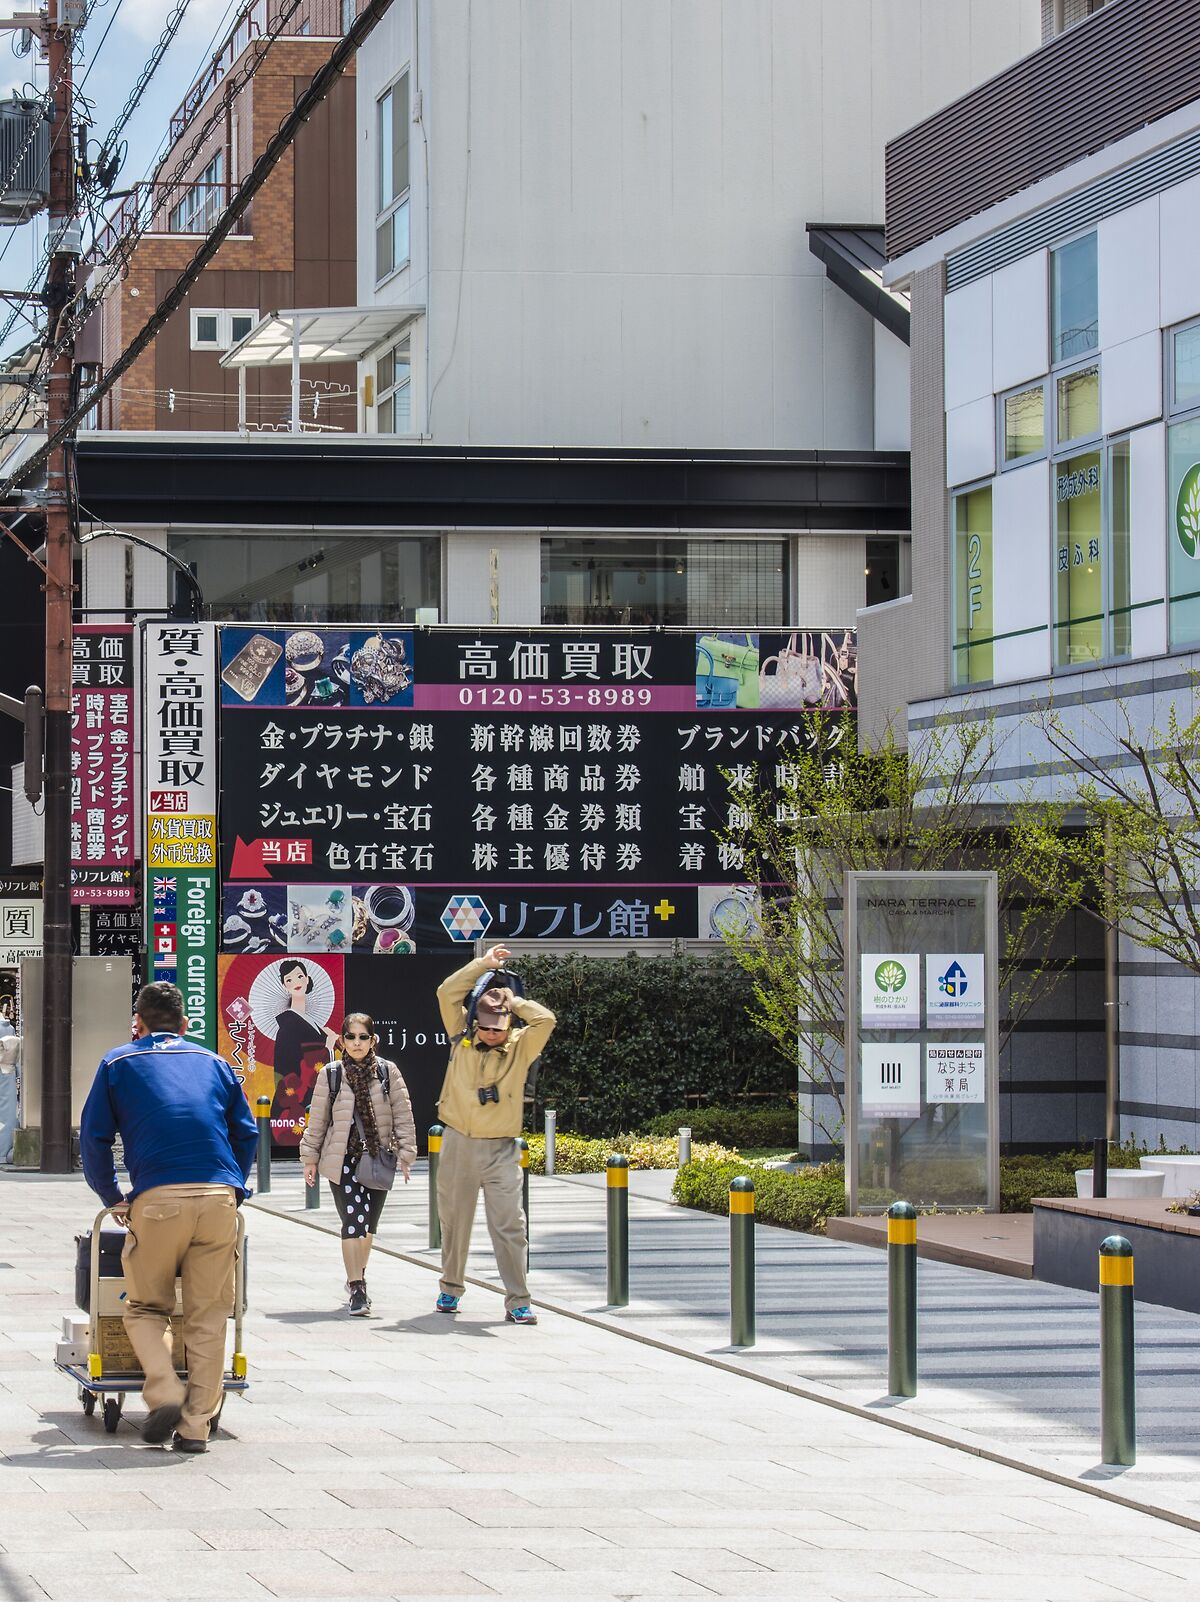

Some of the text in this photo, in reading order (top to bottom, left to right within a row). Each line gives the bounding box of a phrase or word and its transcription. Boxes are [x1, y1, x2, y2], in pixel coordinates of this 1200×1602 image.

[1056, 464, 1099, 502] 形成外科
[1057, 538, 1099, 572] 皮ふ科
[968, 534, 982, 631] 2F
[72, 637, 124, 658] 高価
[458, 641, 653, 680] 高価買取
[72, 664, 124, 685] 買取
[157, 628, 205, 786] 質・高価買取
[459, 687, 652, 706] 0120-53-8989
[260, 722, 434, 752] 金・プラチナ・銀
[470, 723, 641, 752] 新幹線回数券
[86, 694, 105, 860] 時計 ブランド 商品券
[109, 694, 128, 860] 宝石 金・プラチナ ダイヤ
[260, 763, 433, 790] ダイヤモンド
[471, 763, 641, 792] 各種商品券
[162, 792, 187, 811] 当店
[151, 819, 212, 838] 外貨買取
[259, 802, 433, 831] ジュエリー・宝石
[471, 802, 641, 831] 各種金券類
[151, 843, 212, 863] 外币兑换
[261, 841, 307, 861] 当店
[326, 842, 434, 870] 色石宝石
[471, 842, 642, 871] 株主優待券
[4, 881, 39, 891] リフレ館
[78, 870, 123, 882] リフレ館
[867, 898, 976, 907] NARA TERRACE
[6, 909, 32, 935] 質
[500, 899, 650, 938] リフレ館
[97, 933, 141, 944] ダイヤモ
[181, 877, 211, 1041] Foreign currency
[928, 1050, 982, 1058] 処方せん受付
[937, 1061, 976, 1074] ならまち
[944, 1078, 969, 1092] 薬局
